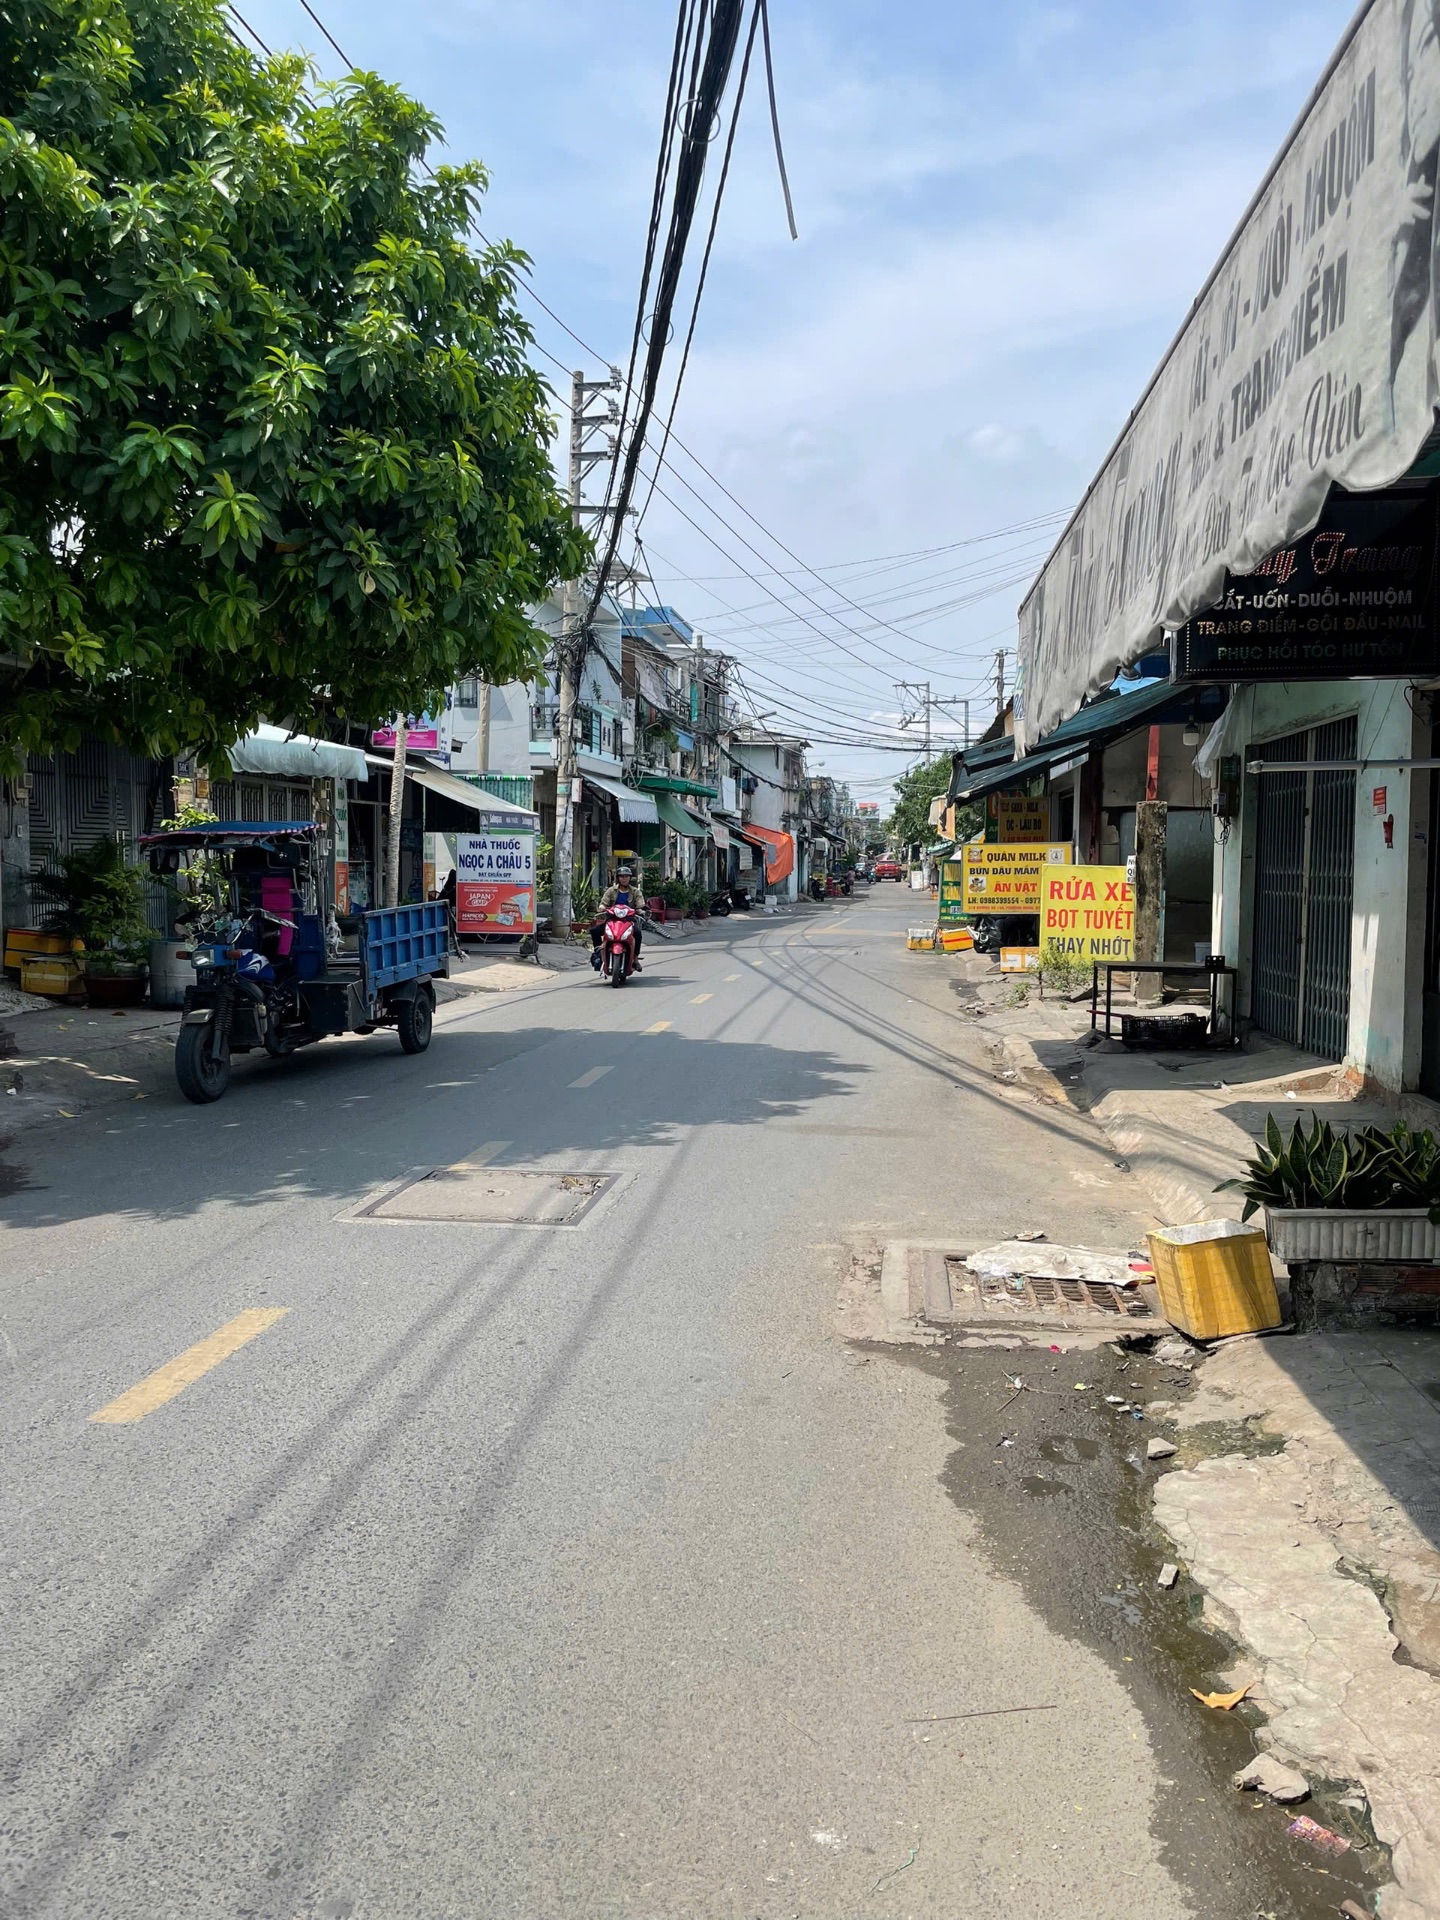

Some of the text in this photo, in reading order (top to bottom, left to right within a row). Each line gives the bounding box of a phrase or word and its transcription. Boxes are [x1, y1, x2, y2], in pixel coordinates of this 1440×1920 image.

[1197, 620, 1252, 636] TRANG
[1218, 646, 1263, 665] PHỤC
[1302, 643, 1337, 658] TÓC
[469, 838, 521, 850] NHÀ THUỐC
[459, 851, 531, 871] NGỌC A CHÂU 5
[986, 850, 1047, 863] QUÁN MILK
[969, 865, 989, 875] BÚN
[992, 865, 1012, 877] ĐẬU
[993, 880, 1038, 894] ĂN VẬT
[1049, 876, 1133, 902] RỬA XE
[1046, 904, 1134, 932] BỌT TUYẾT
[1047, 935, 1131, 956] THAY NHỚT
